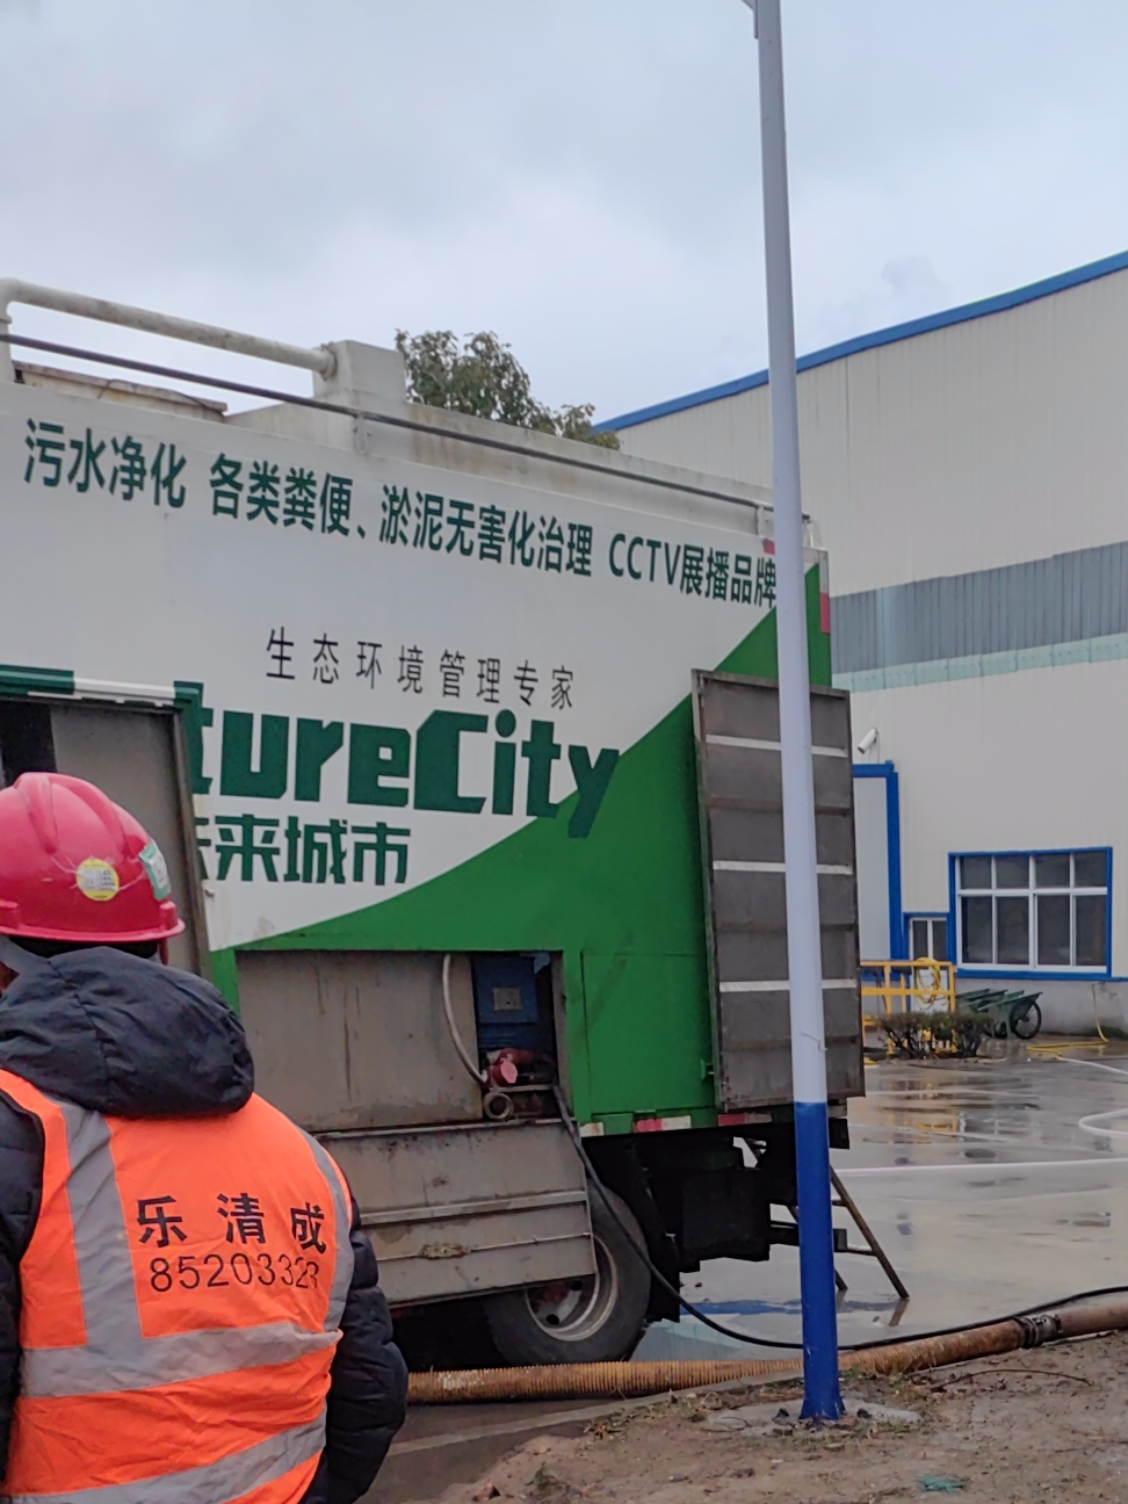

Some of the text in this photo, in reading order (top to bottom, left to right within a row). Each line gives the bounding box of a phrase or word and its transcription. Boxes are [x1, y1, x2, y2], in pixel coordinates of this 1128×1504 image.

[24, 418, 776, 608] 污水净化 各类粪便、淤泥无害化治理 CCTV展播品牌
[266, 626, 574, 710] 生态环境管理专家
